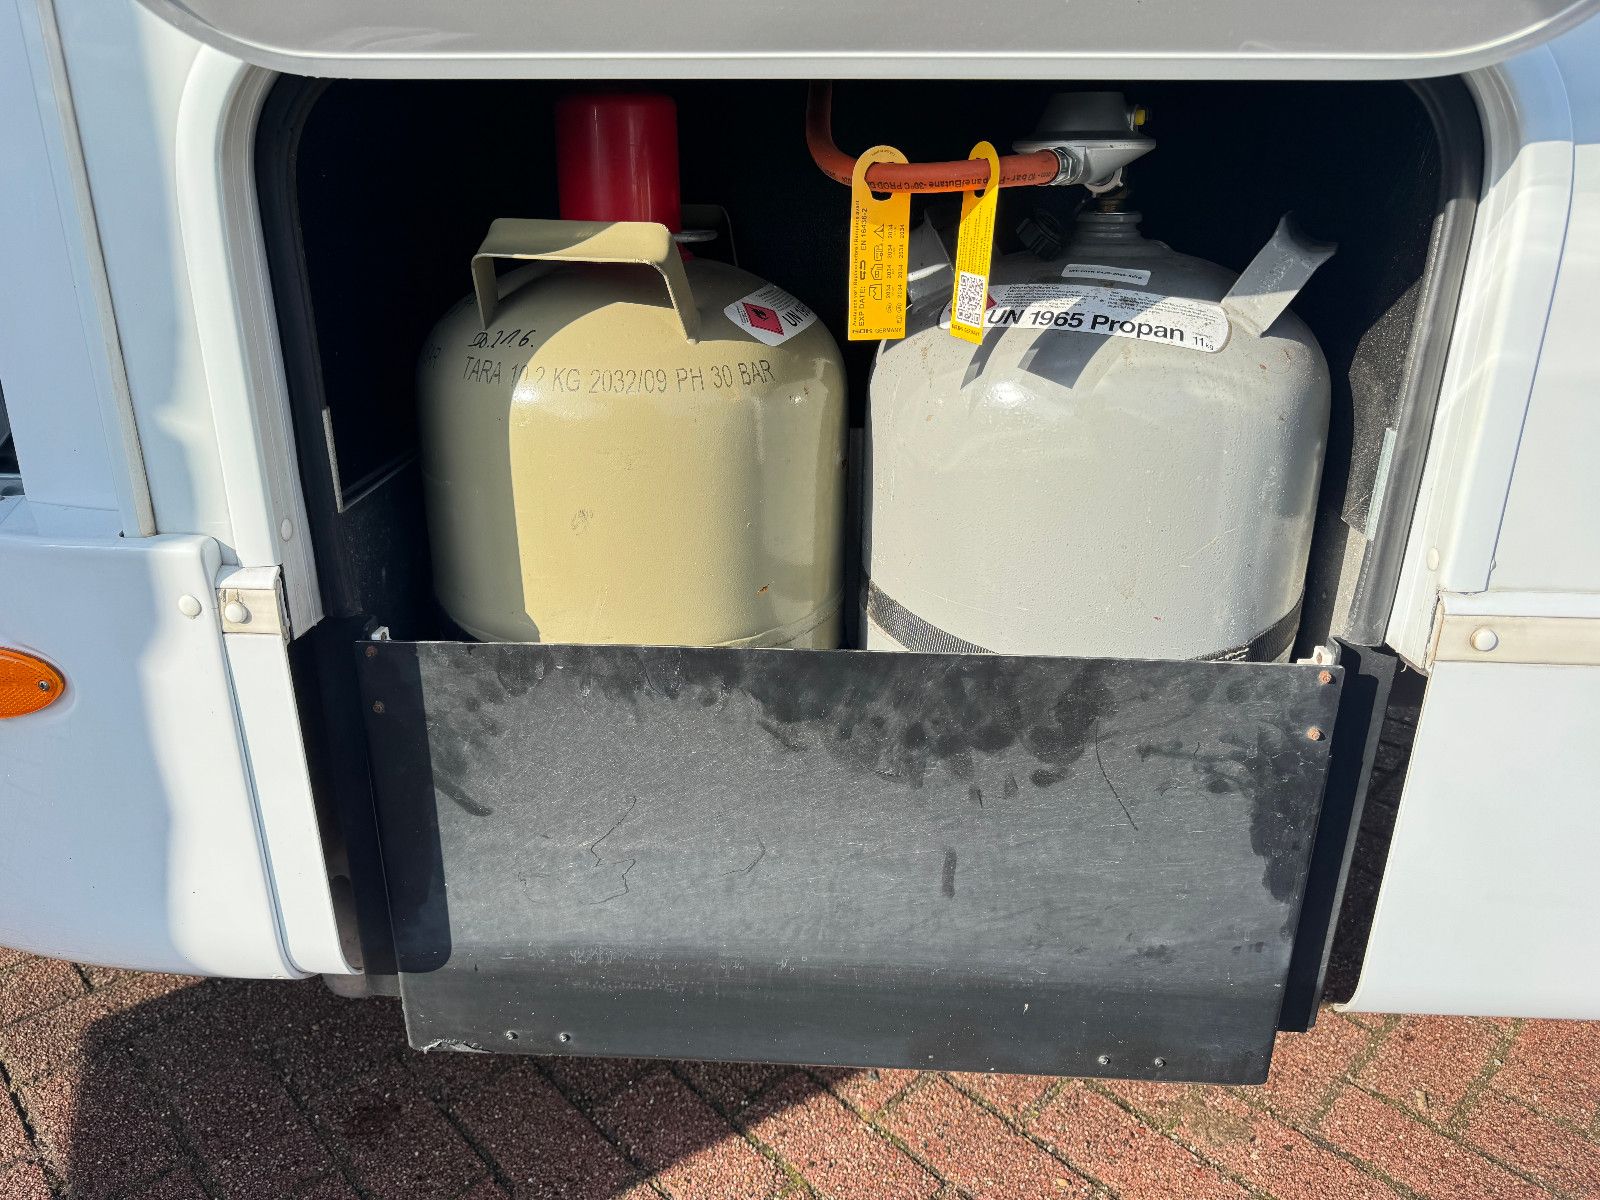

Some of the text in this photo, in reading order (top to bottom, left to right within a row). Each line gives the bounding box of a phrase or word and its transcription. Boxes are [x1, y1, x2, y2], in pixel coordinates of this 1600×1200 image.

[860, 239, 867, 251] EN
[781, 309, 803, 327] UN
[986, 308, 1024, 325] UN
[1031, 310, 1084, 328] 1965
[1090, 313, 1185, 342] Propan
[1193, 336, 1204, 347] 11
[463, 356, 775, 394] TARA 102 KG 2032/09 PH 30 BAR
